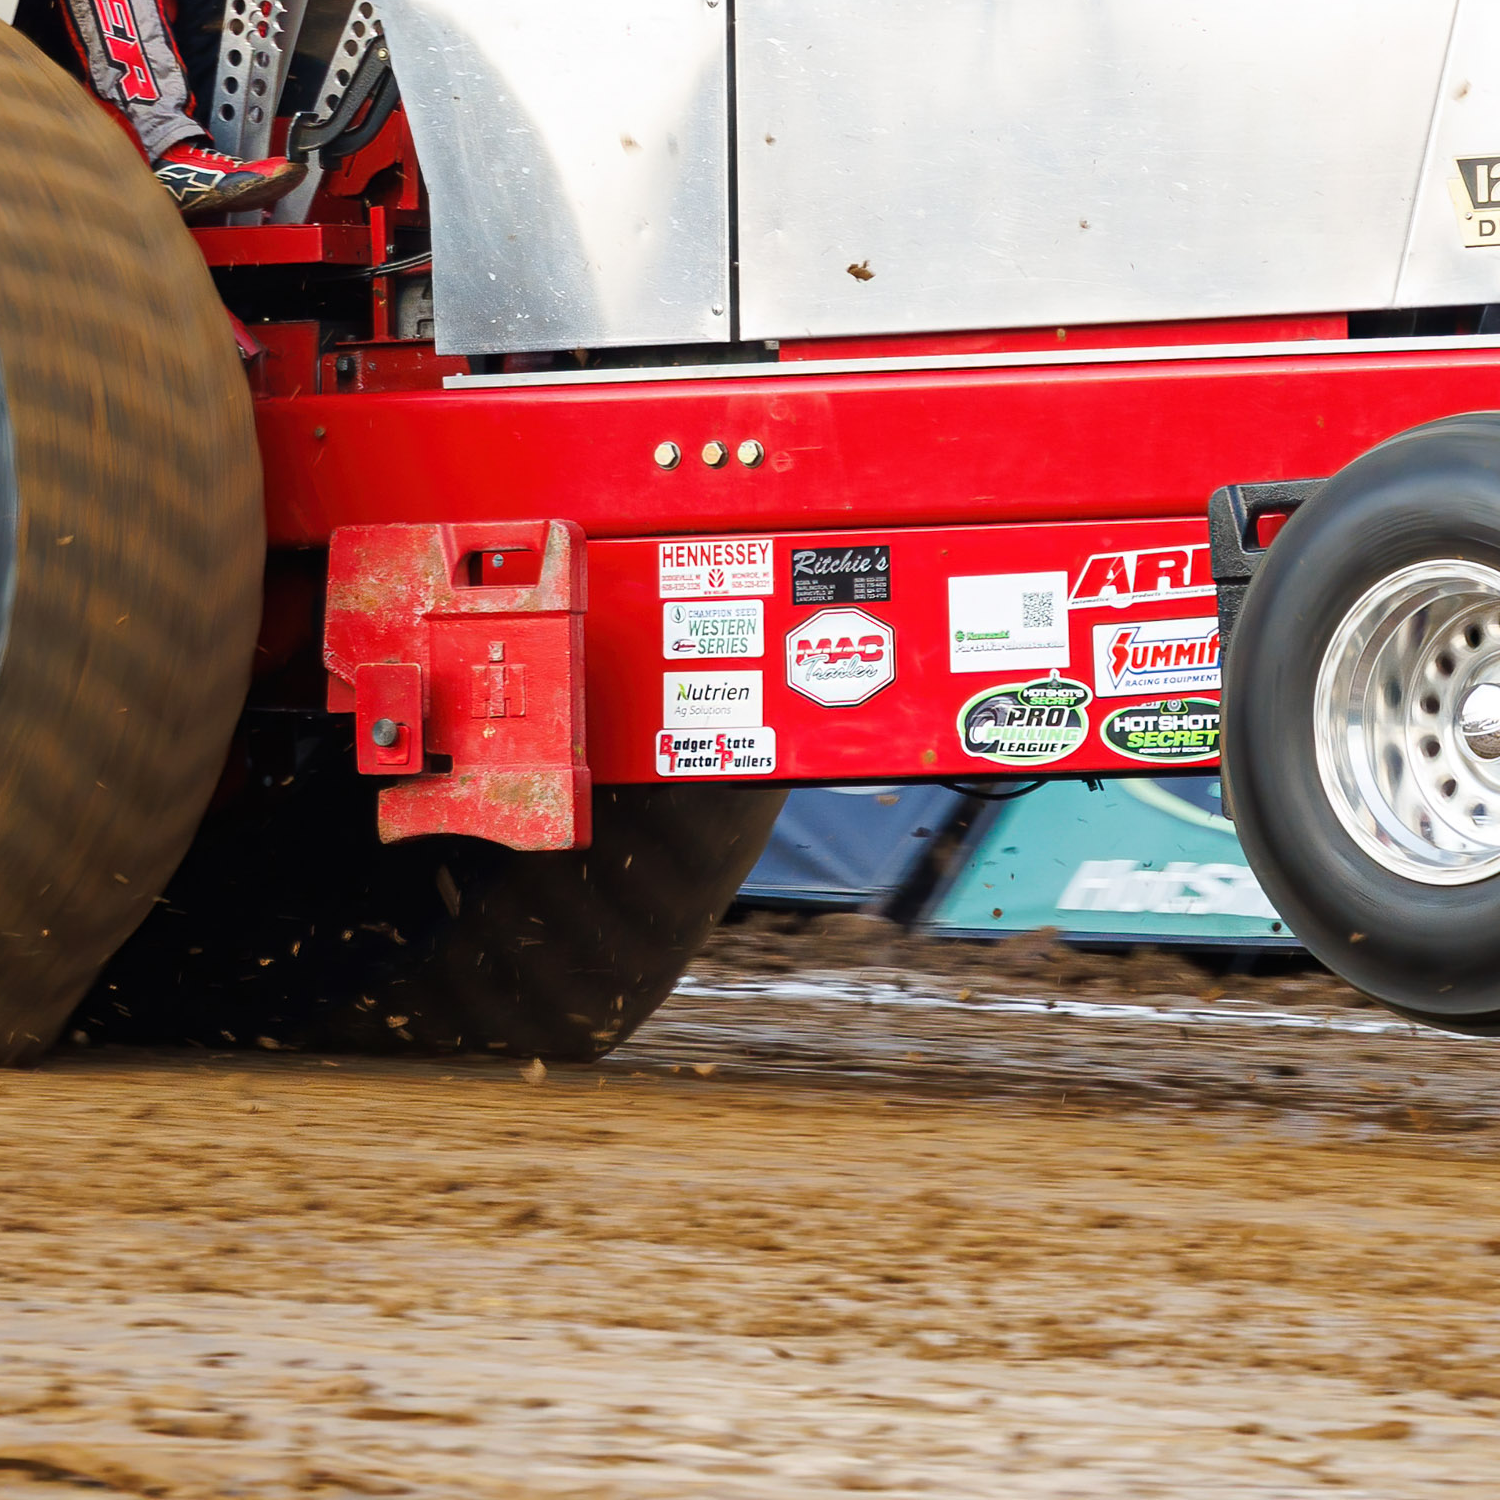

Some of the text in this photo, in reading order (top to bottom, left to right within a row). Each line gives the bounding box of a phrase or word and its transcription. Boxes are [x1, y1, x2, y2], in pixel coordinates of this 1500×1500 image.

[662, 543, 770, 568] HENNESSEY
[793, 547, 889, 577] Ritchie's
[688, 608, 757, 618] CHAMPION SEED
[688, 619, 757, 636] WESTERN
[697, 637, 749, 655] SERIES
[795, 634, 885, 666] MAC
[801, 654, 879, 682] Trailer
[1125, 674, 1219, 687] RACING EQUIPMENT
[676, 682, 750, 701] Nutrien
[1029, 697, 1078, 706] SECRET
[674, 705, 732, 718] Ag Solutions
[1006, 707, 1066, 727] PRO
[986, 727, 1081, 741] PULLING
[1126, 730, 1220, 748] SECRET
[660, 733, 756, 756] Badger State
[998, 742, 1059, 753] LEAGUE
[667, 750, 773, 773] Tractor Pullers
